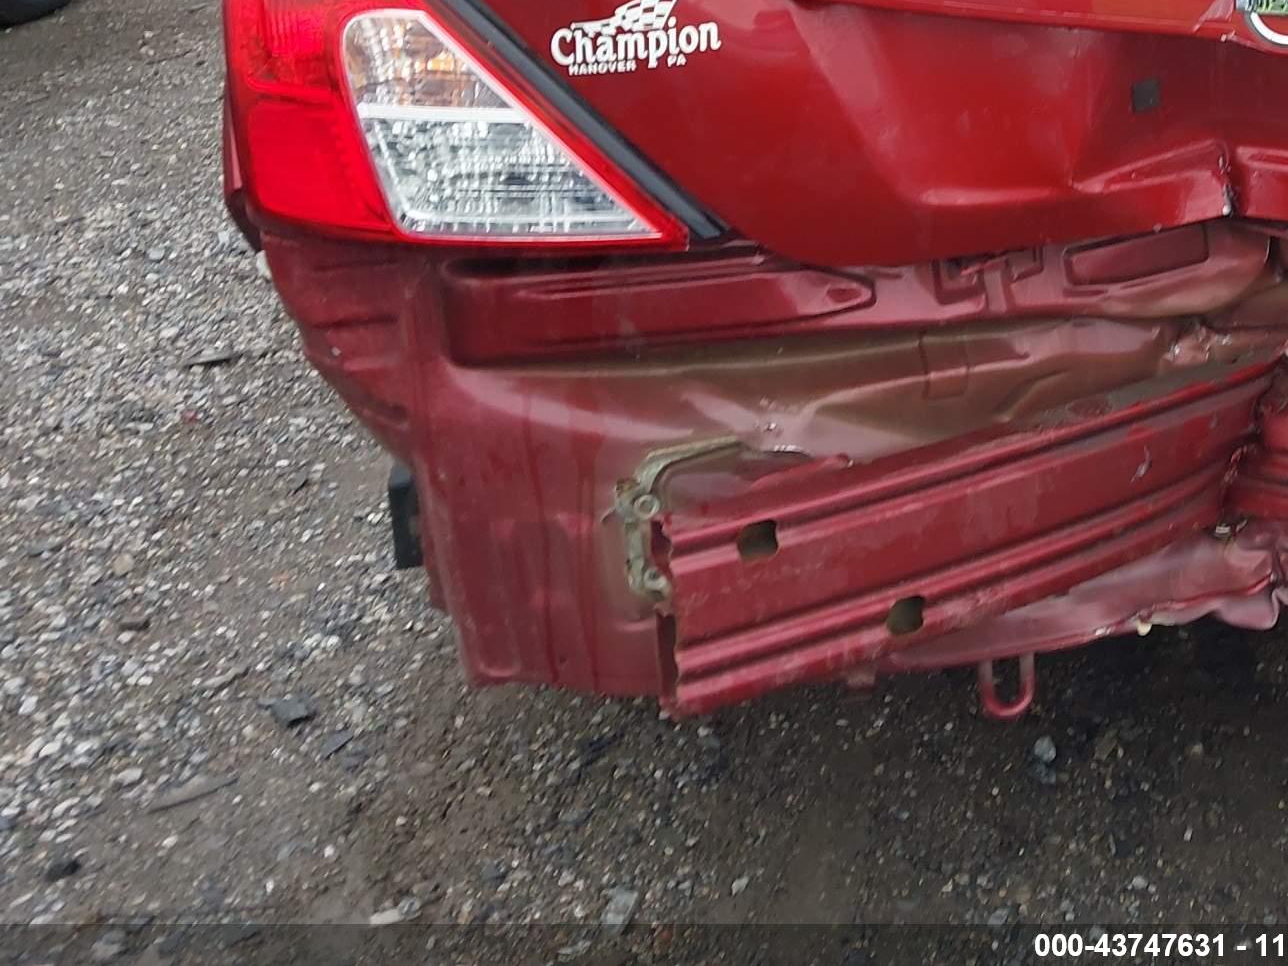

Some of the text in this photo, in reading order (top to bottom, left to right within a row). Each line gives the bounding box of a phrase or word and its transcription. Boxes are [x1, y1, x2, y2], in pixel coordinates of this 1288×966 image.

[550, 16, 722, 68] Champion
[568, 54, 688, 76] HANOVER PA
